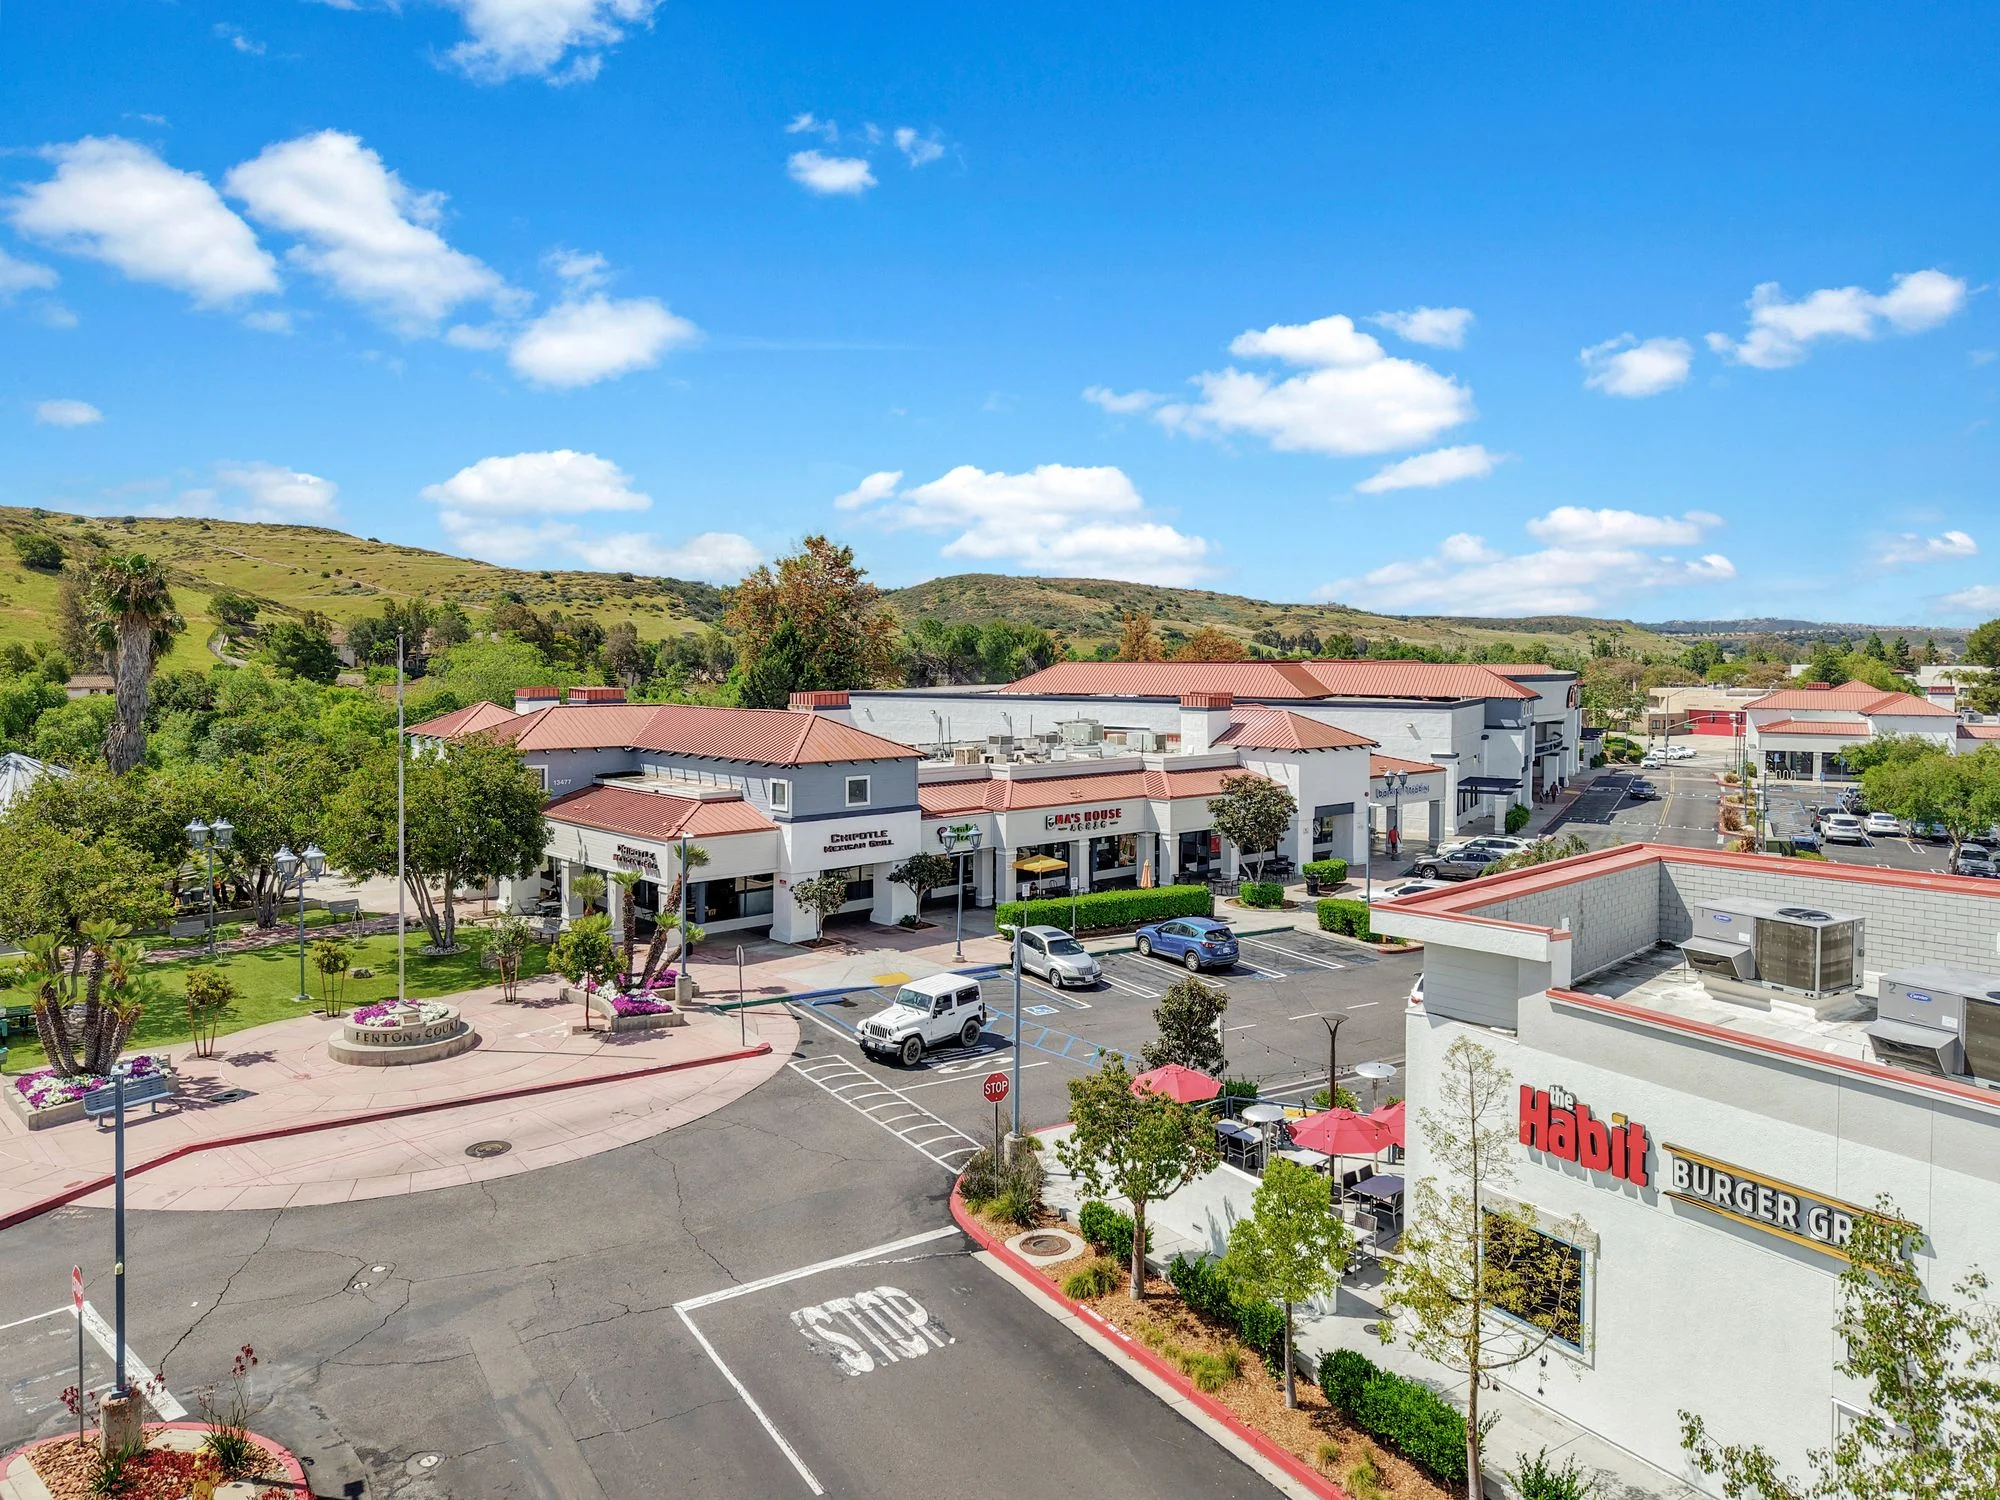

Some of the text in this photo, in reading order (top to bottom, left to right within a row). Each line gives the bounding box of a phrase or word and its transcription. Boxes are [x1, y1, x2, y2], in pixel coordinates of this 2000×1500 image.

[1055, 808, 1122, 825] MA'S HOUSE
[823, 839, 894, 853] MEXICAN GRILL
[830, 829, 888, 843] CHIPOTLE
[355, 1019, 458, 1043] FENTON COURT
[984, 1080, 1008, 1095] STOP
[1549, 1084, 1574, 1110] the
[1519, 1084, 1649, 1188] Habit
[1673, 1156, 1800, 1228] BURGER
[791, 1286, 945, 1376] STOP
